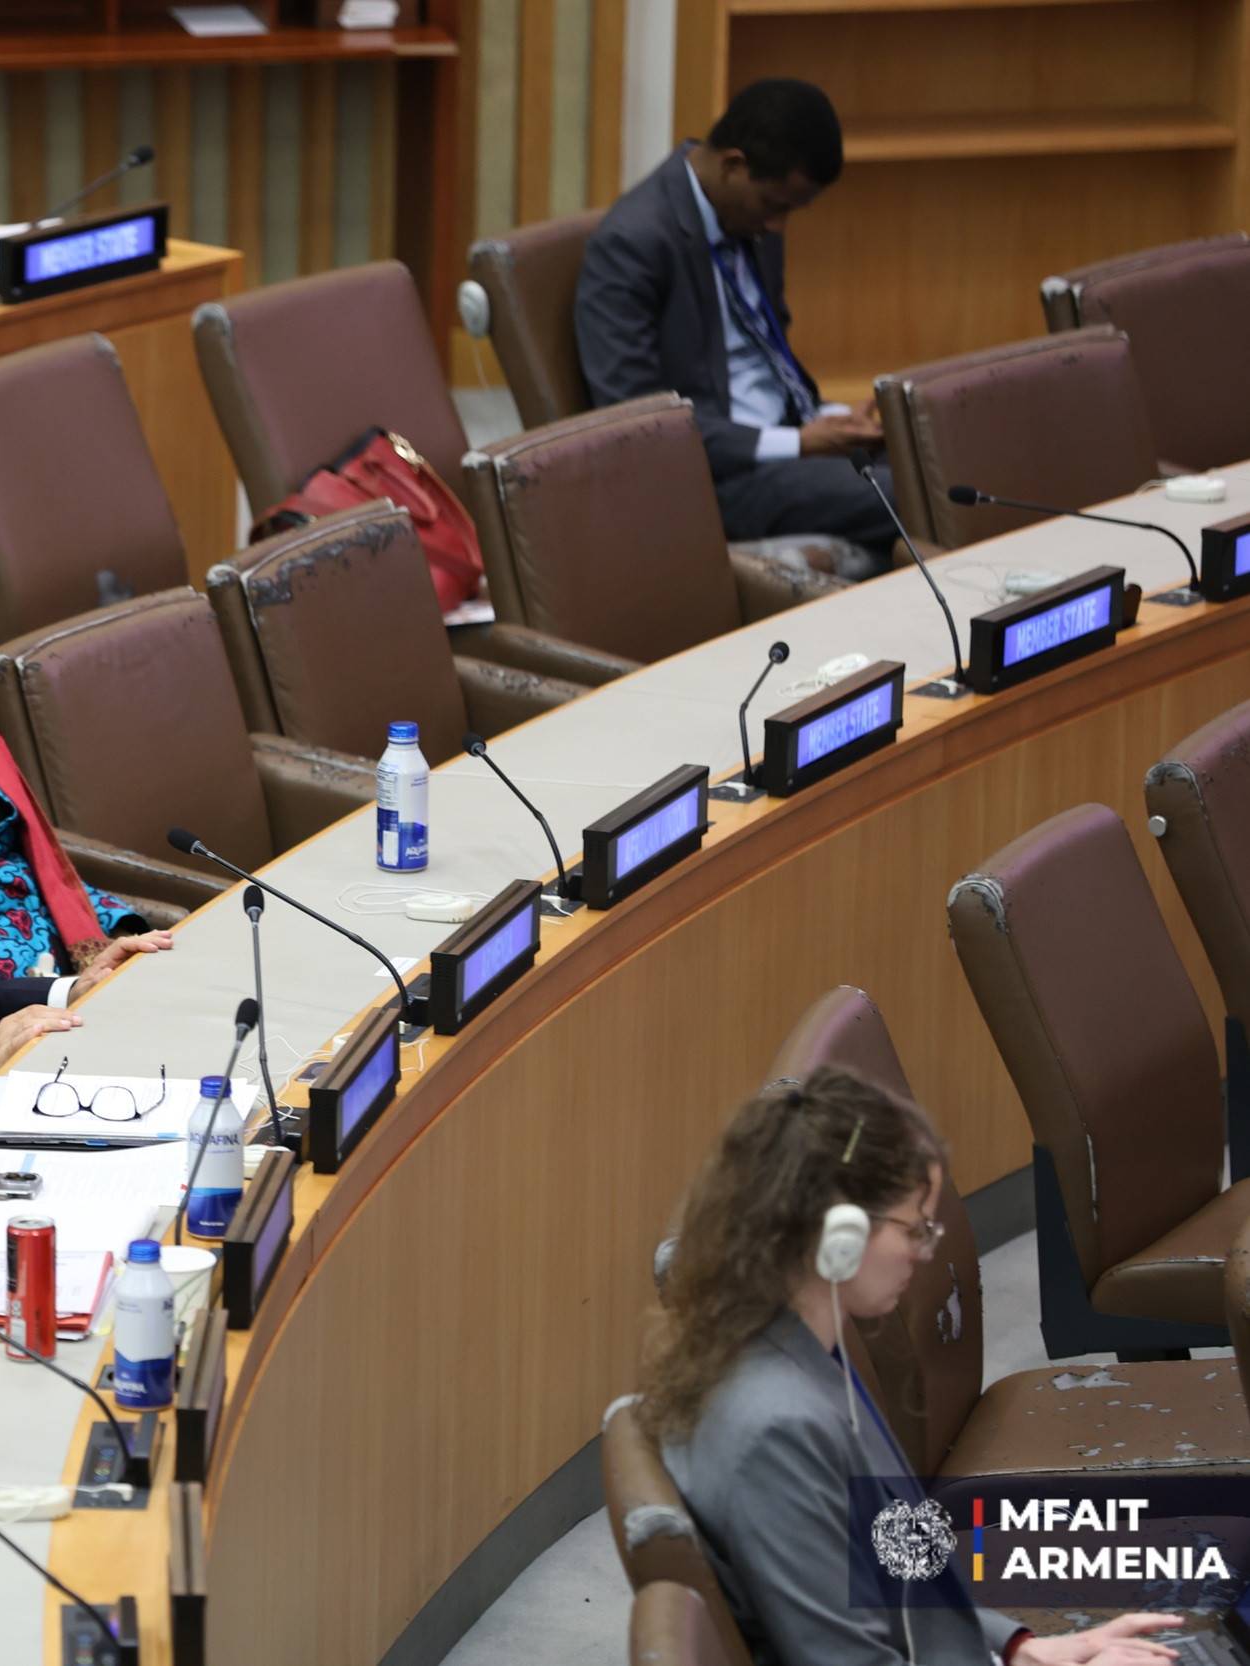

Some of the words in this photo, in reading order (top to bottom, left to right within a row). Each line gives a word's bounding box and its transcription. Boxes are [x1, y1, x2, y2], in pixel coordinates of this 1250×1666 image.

[1016, 611, 1060, 659] MEMBER
[1062, 597, 1097, 639] STATE
[808, 710, 848, 762] MEMBER
[851, 695, 879, 737] STATE
